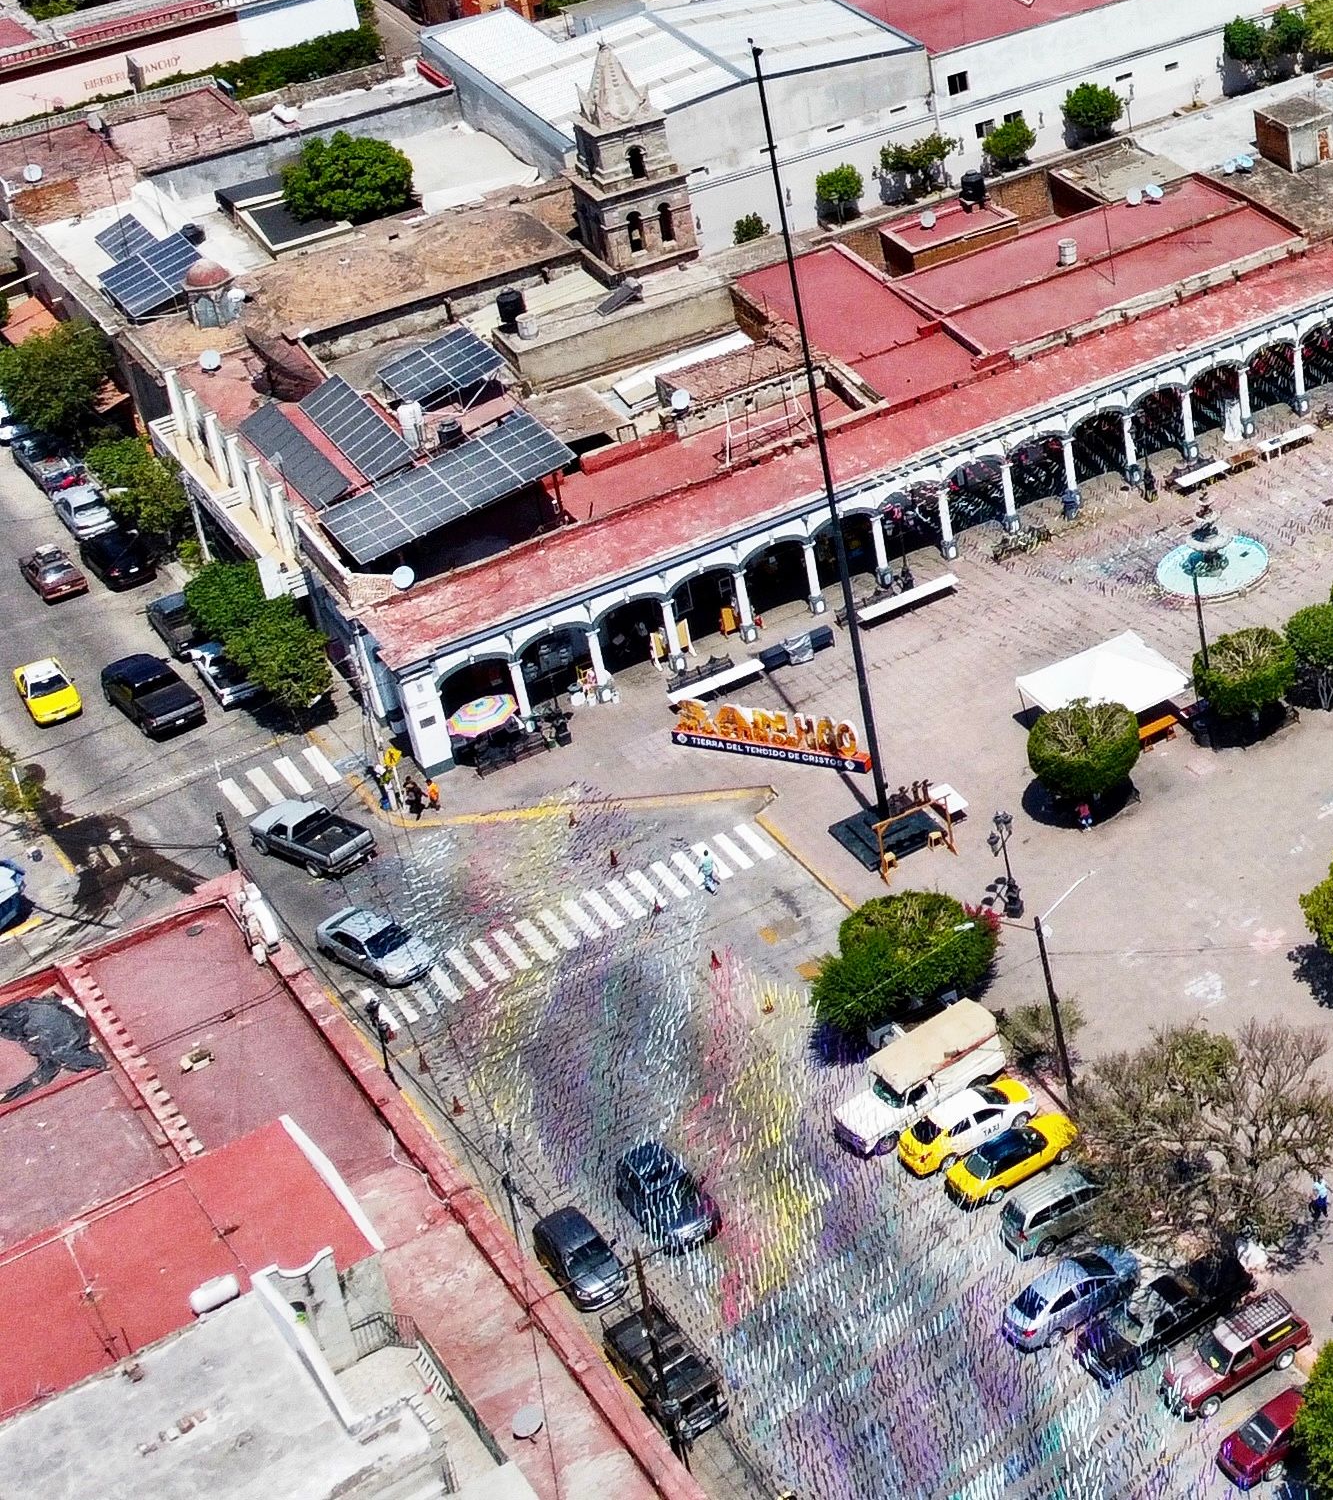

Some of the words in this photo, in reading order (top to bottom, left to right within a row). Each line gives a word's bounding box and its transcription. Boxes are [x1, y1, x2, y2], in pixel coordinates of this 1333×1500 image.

[691, 736, 724, 750] TIERRA
[726, 742, 744, 752] DEL
[745, 745, 786, 759] TENDIDO
[787, 751, 800, 760] DE
[801, 752, 843, 767] CRISTOS
[983, 1123, 1000, 1136] TAXI
